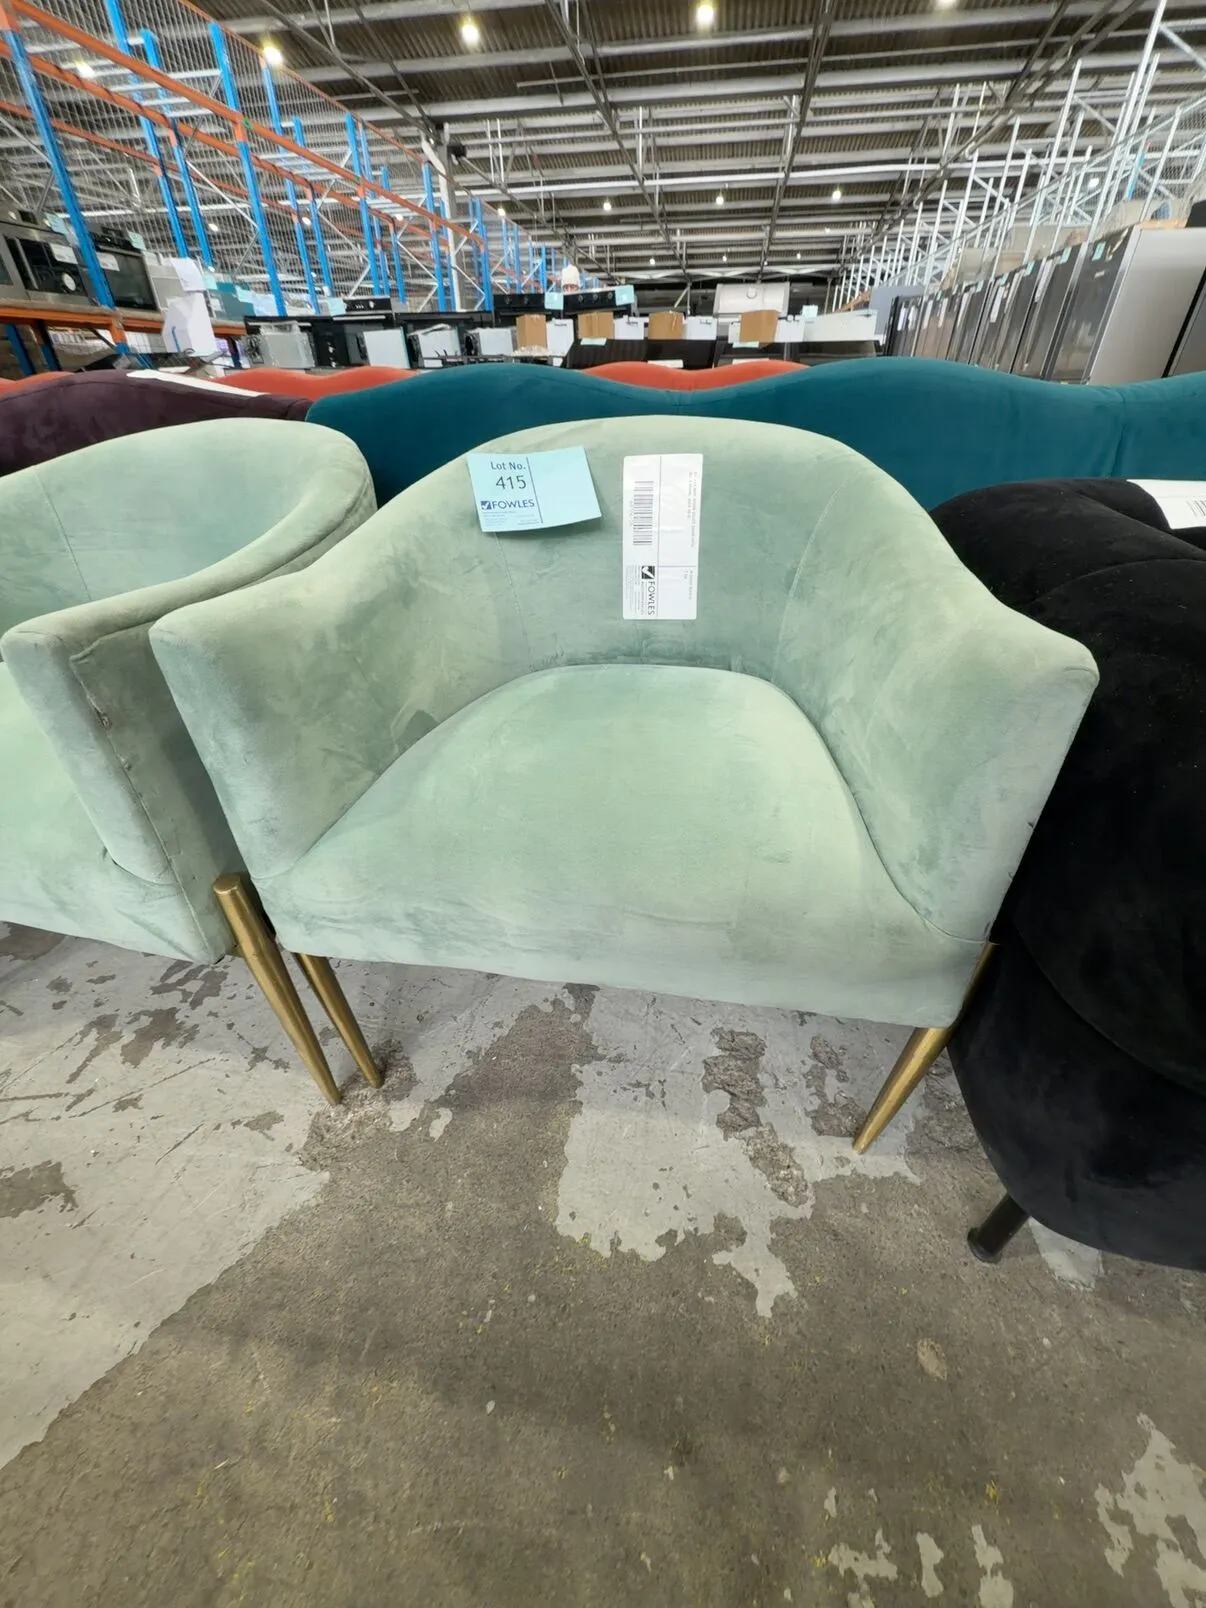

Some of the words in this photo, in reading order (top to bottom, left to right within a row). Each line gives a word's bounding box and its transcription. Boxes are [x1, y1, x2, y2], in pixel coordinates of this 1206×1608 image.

[490, 461, 506, 470] Lot
[509, 461, 526, 470] No.
[495, 475, 527, 490] 415
[492, 499, 535, 510] FOWLES
[647, 581, 655, 616] FOWLES
